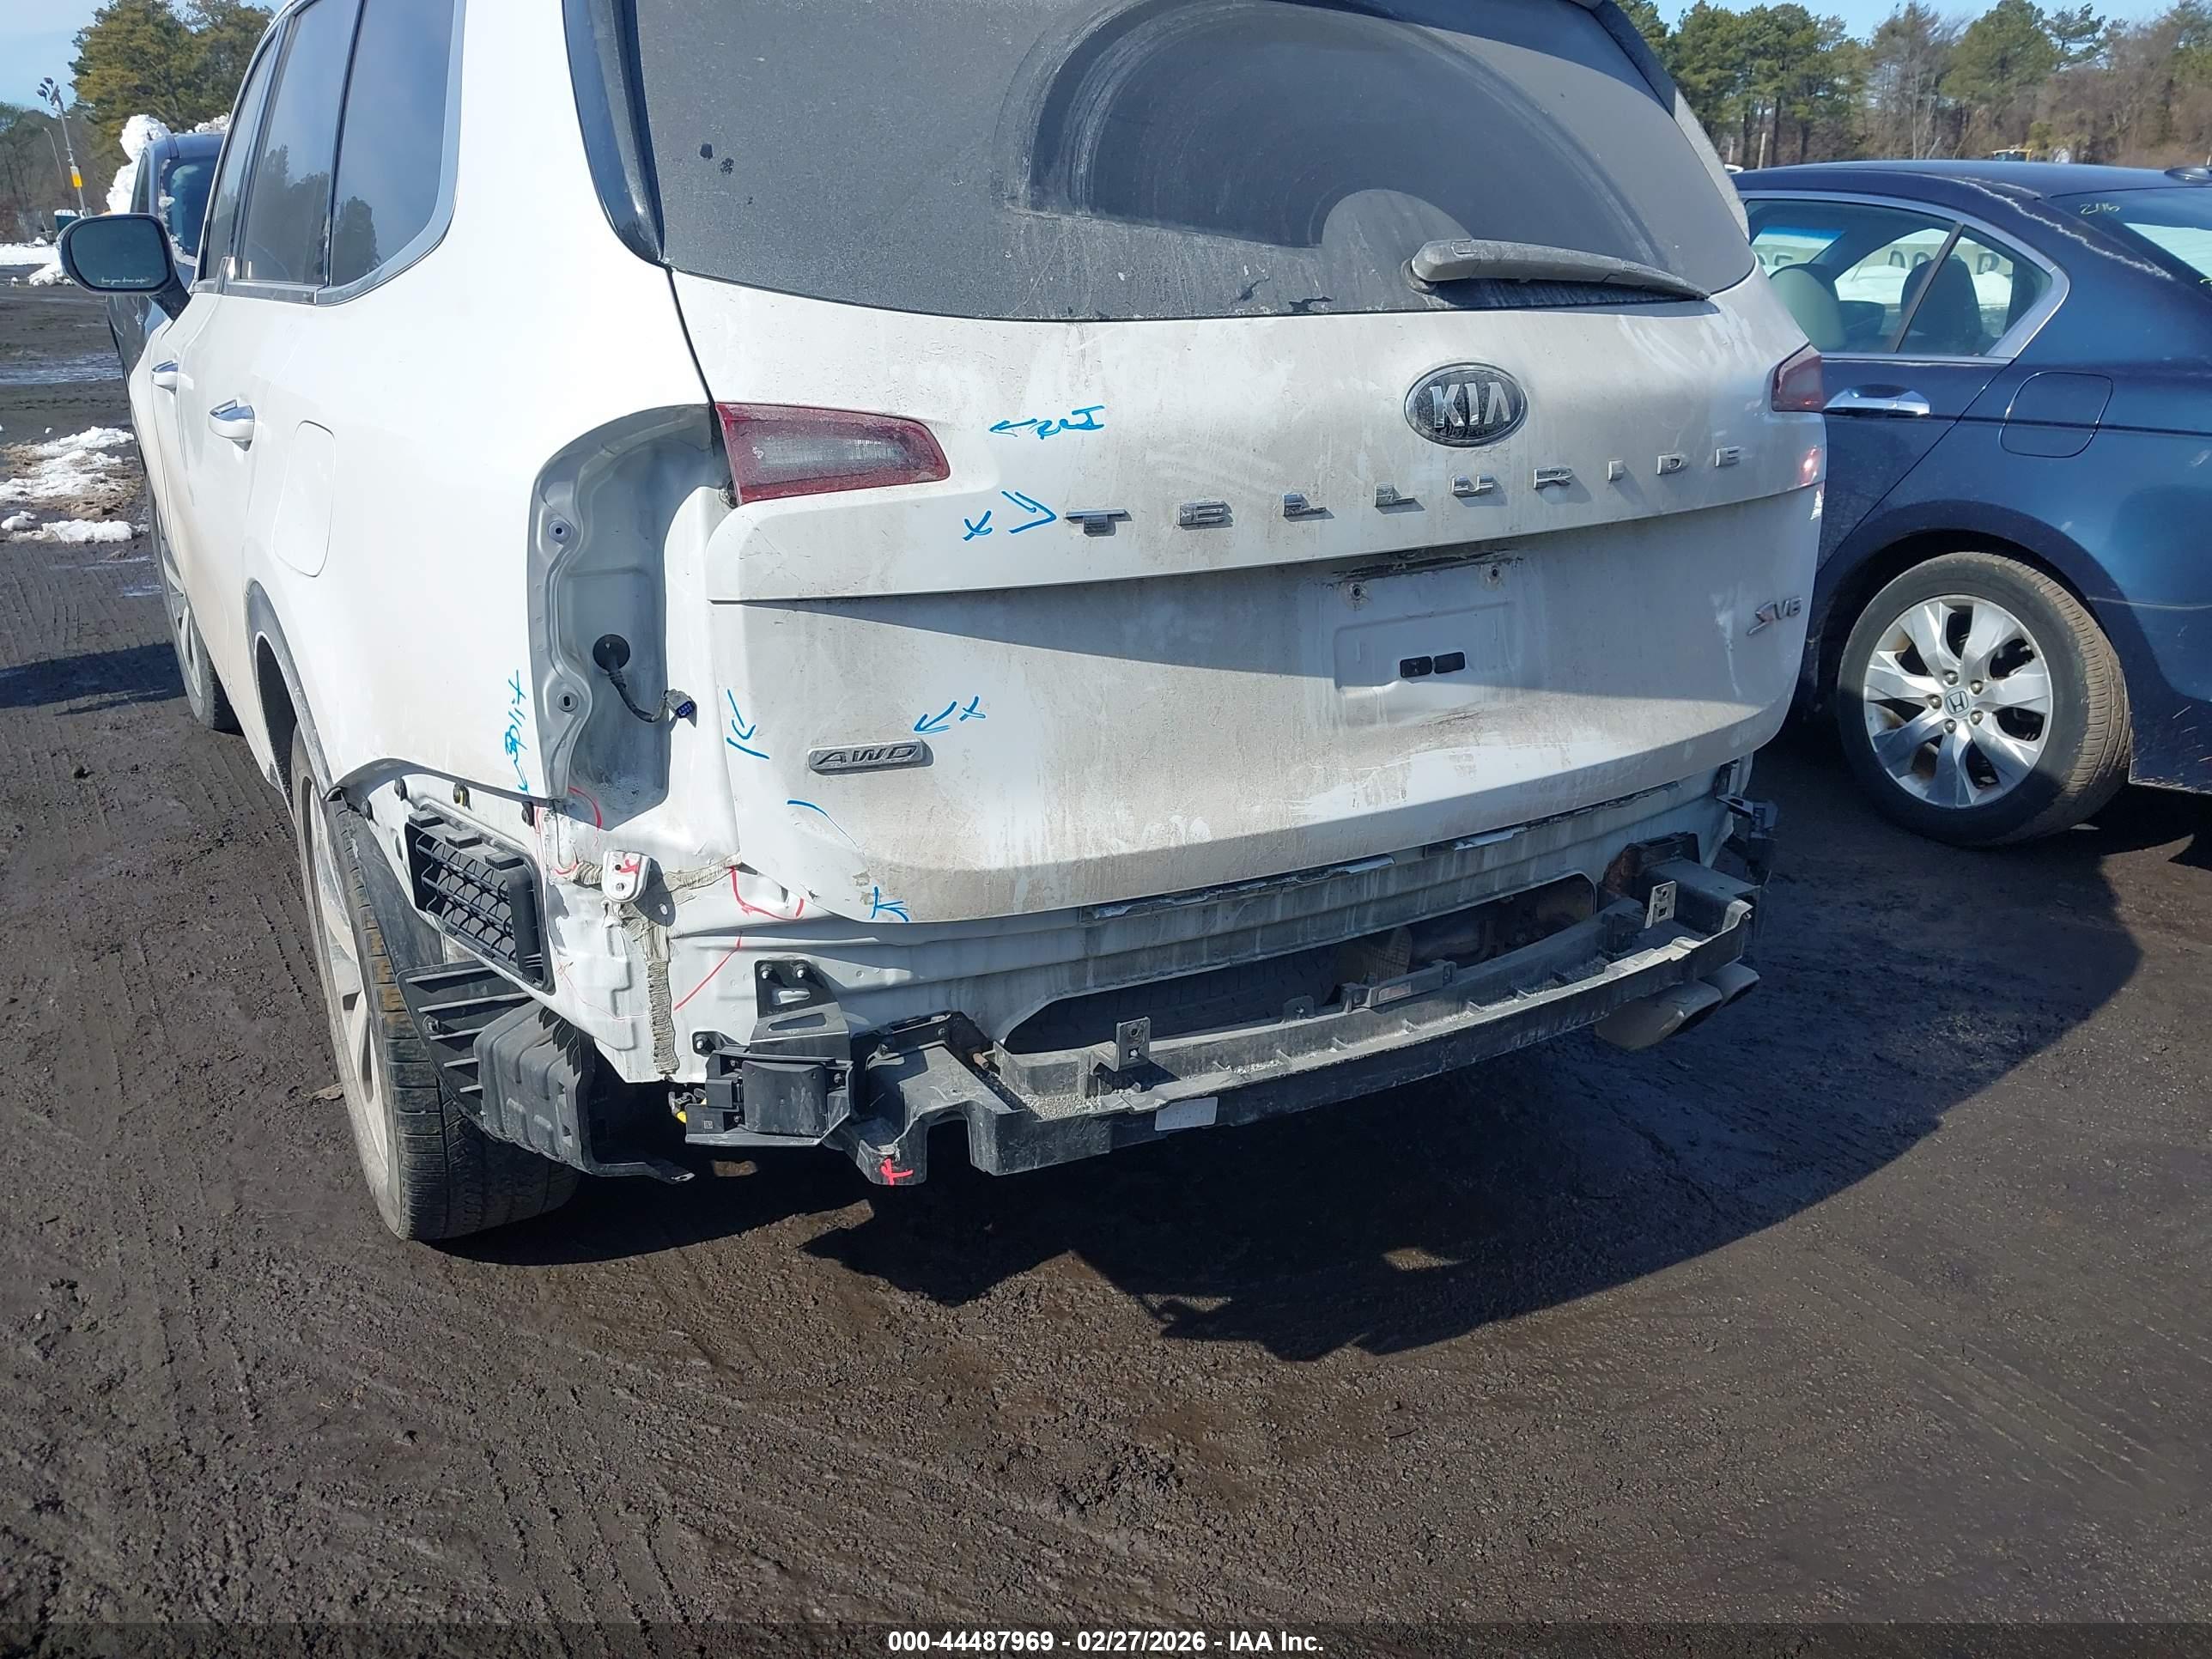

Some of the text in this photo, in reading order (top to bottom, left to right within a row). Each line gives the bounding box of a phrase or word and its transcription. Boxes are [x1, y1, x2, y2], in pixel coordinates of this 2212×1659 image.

[1430, 381, 1511, 428] KIA
[1064, 446, 1740, 534] TELLURIDE
[816, 744, 917, 765] AWD
